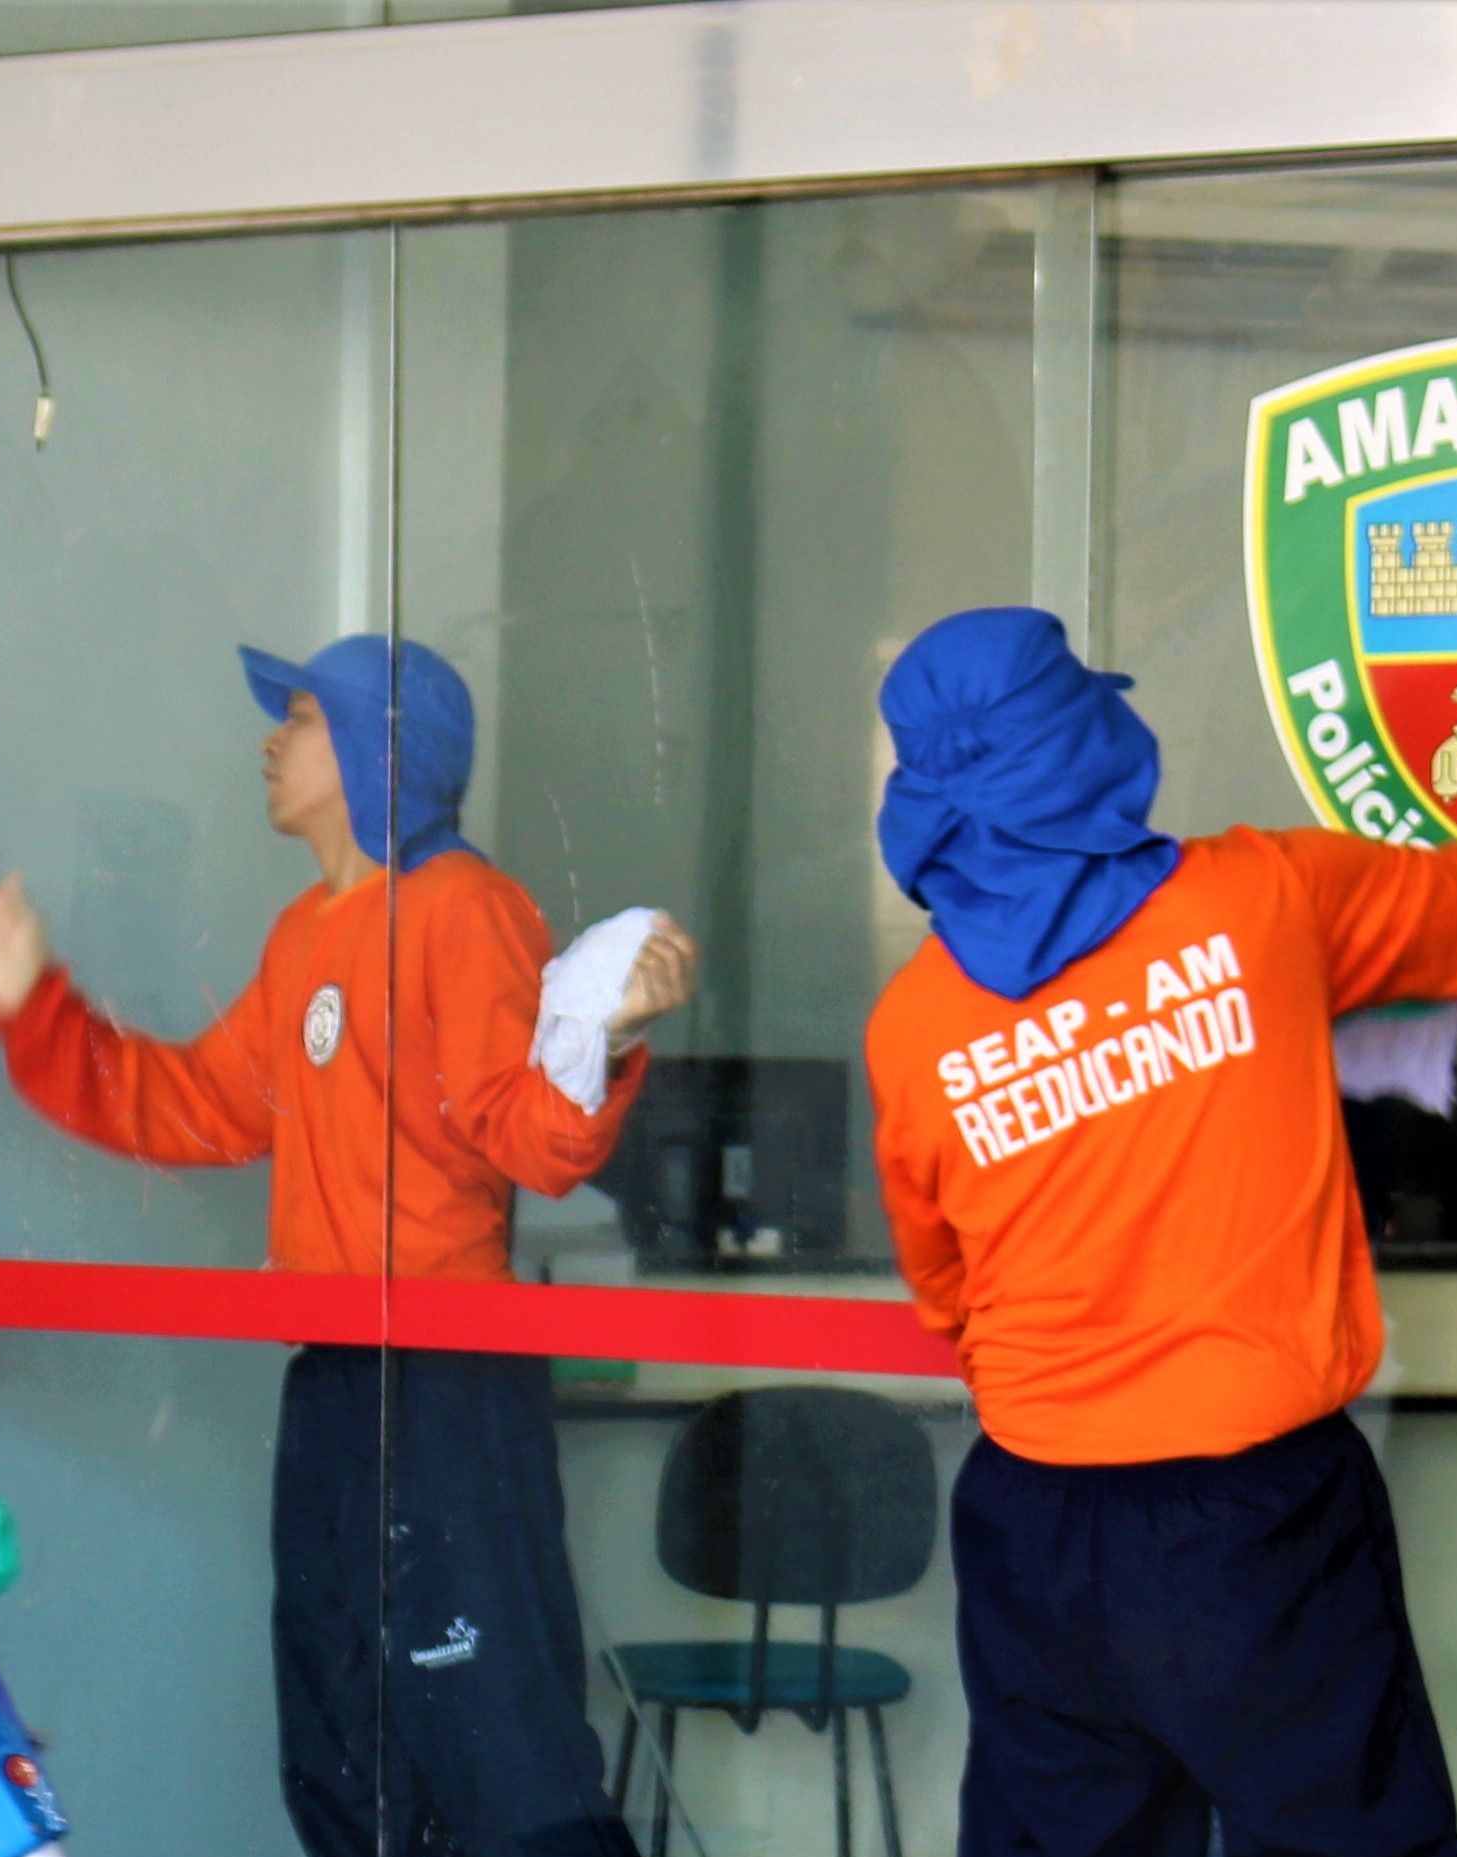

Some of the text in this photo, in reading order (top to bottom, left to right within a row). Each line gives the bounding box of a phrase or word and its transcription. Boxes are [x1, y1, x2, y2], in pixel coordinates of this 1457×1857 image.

[936, 998, 1087, 1100] SEAP
[1145, 933, 1242, 1013] AM
[952, 986, 1256, 1169] REEDUCANDO
